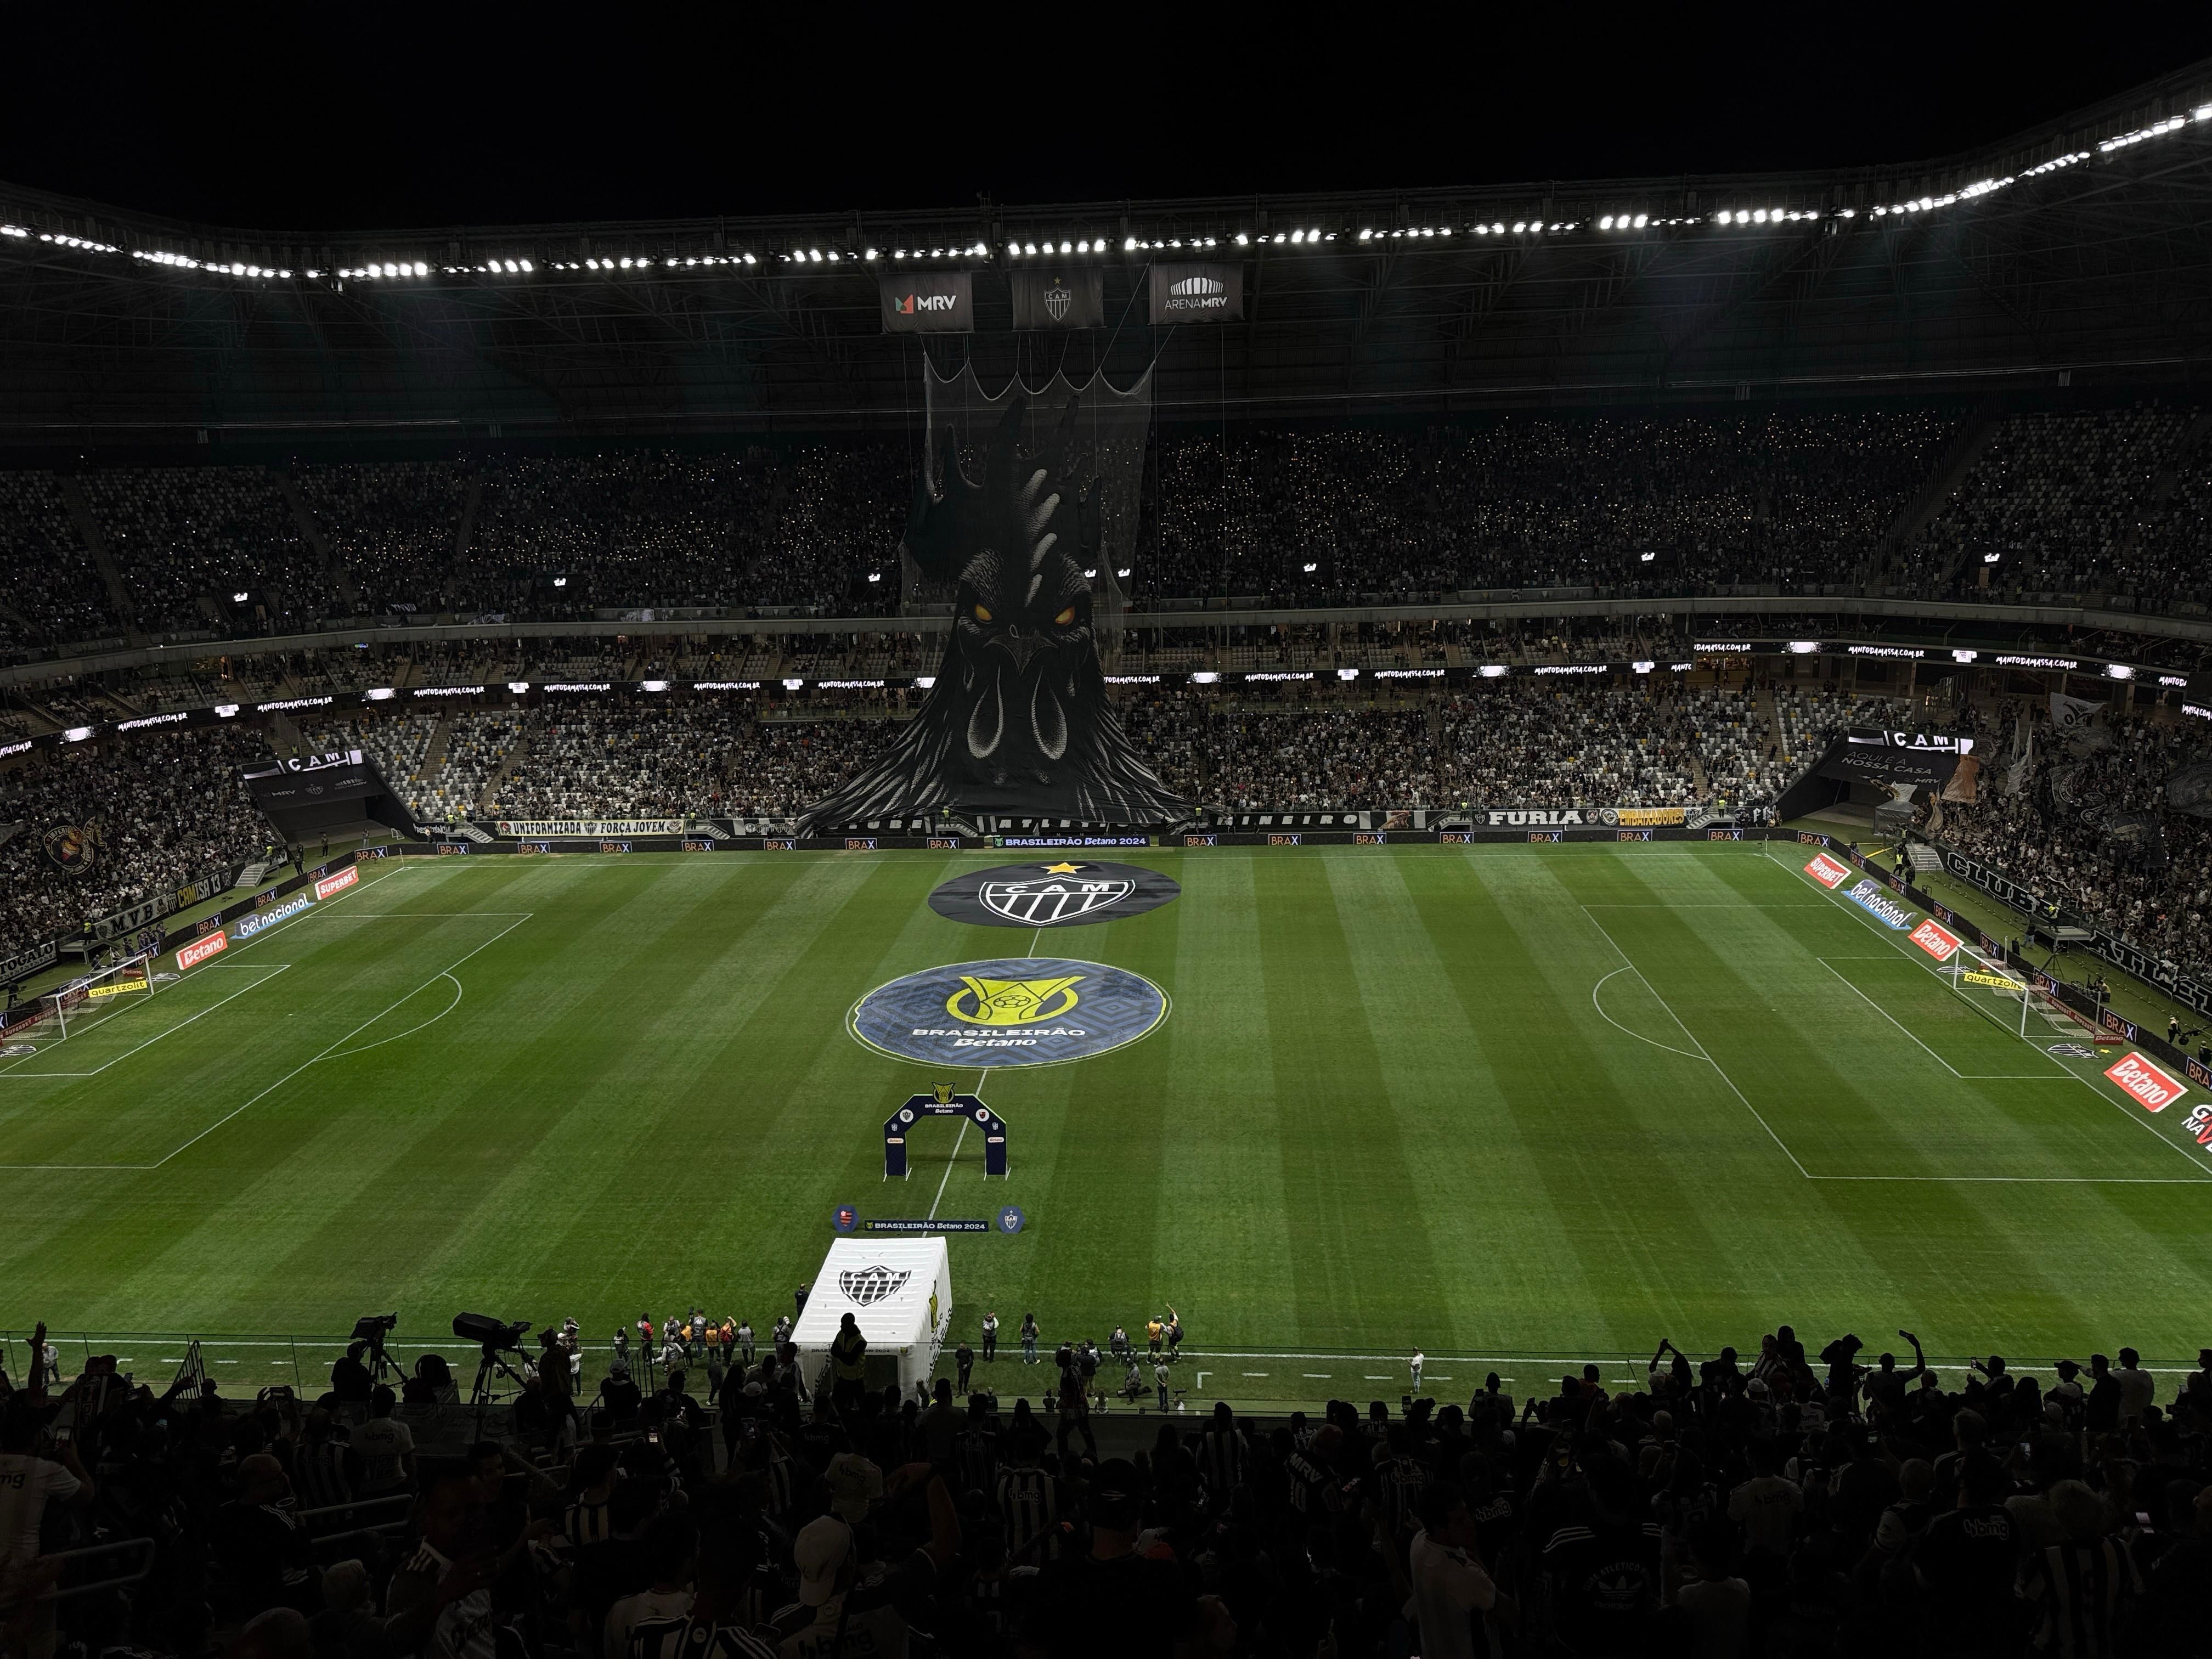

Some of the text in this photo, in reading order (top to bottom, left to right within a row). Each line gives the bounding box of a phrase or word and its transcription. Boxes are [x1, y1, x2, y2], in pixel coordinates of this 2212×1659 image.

[917, 295, 957, 311] MRV
[1848, 646, 1925, 659] MANTODAMASSA.COM.BR
[1995, 656, 2078, 670] MANTODAMASSA.COM.BR
[1245, 672, 1314, 682] MANTODAMASSA.COM.BR
[1374, 669, 1446, 680] MANTODAMASSA.COM.BR
[1534, 665, 1607, 676] MANTODAMASSA.COM.BR
[693, 681, 761, 691] MANTODAMASSA.COM.BR
[818, 680, 885, 689] MANTODAMASSA.COM.BR
[1104, 675, 1160, 685] TODAMASSA.COM.BR
[414, 686, 485, 697] MANTODAMASSA.COM.BR
[544, 683, 612, 693] MANTODAMASSA.COM.BR
[257, 696, 334, 713] MANTODAMASSA.COM.BR
[118, 712, 188, 732] MANTODAMASSA.COM.BR
[1846, 751, 1883, 761] AQUI
[1841, 757, 1932, 775] NOSSA CASA
[1488, 810, 1583, 825] FURIA
[1619, 808, 1685, 826] EMBAIXADORES
[514, 821, 665, 836] UNIFORMIZADA FORÇA JOVEM
[1005, 837, 1147, 847] BRASILEIRÃO Betano 2024
[1187, 837, 1215, 846] BRAX
[1271, 836, 1299, 845] BRAX
[1356, 834, 1384, 844] BRAX
[1442, 834, 1471, 844] BRAX
[1531, 833, 1560, 843] BRAX
[1620, 831, 1650, 842] BRAX
[1711, 831, 1740, 841] BRAX
[1801, 833, 1829, 848] BRAX
[439, 845, 466, 855] BRAX
[521, 844, 548, 854] BRAX
[602, 843, 629, 853] BRAX
[684, 842, 711, 851] BRAX
[766, 840, 794, 850] BRAX
[848, 840, 875, 850] BRAX
[929, 839, 957, 849] BRAX
[356, 848, 385, 861] BRAX
[1851, 853, 1864, 871] BRAX
[309, 867, 326, 883] BRAX
[1809, 857, 1844, 883] SUPERBET
[320, 870, 357, 894] SUPERBET
[1005, 883, 1110, 893] CAM
[1890, 877, 1905, 896] BRAX
[177, 874, 222, 908] CAMISA 13
[257, 889, 277, 908] BRAX
[1934, 904, 1953, 926] BRAX
[199, 915, 221, 935] BRAX
[1913, 923, 1951, 956] Betano
[183, 937, 224, 967] Betano
[1981, 935, 1997, 959] BRAX
[91, 980, 145, 997] quartzolit
[2035, 973, 2057, 997] BRAX
[2051, 999, 2072, 1018] SUPERBET
[2074, 1014, 2095, 1034] SUPERBET
[2106, 1013, 2134, 1041] BRAX
[911, 1026, 1086, 1037] BRASILEIRÃO
[952, 1038, 1037, 1048] Betano
[2111, 1058, 2169, 1104] Betano
[850, 1272, 900, 1280] CAM
[372, 1432, 394, 1444] bmg
[1290, 1452, 1324, 1484] MRV
[845, 1468, 866, 1485] bmg
[1017, 1488, 1041, 1504] bmg
[1482, 1499, 1513, 1521] bmg
[1974, 1516, 2010, 1541] bmg
